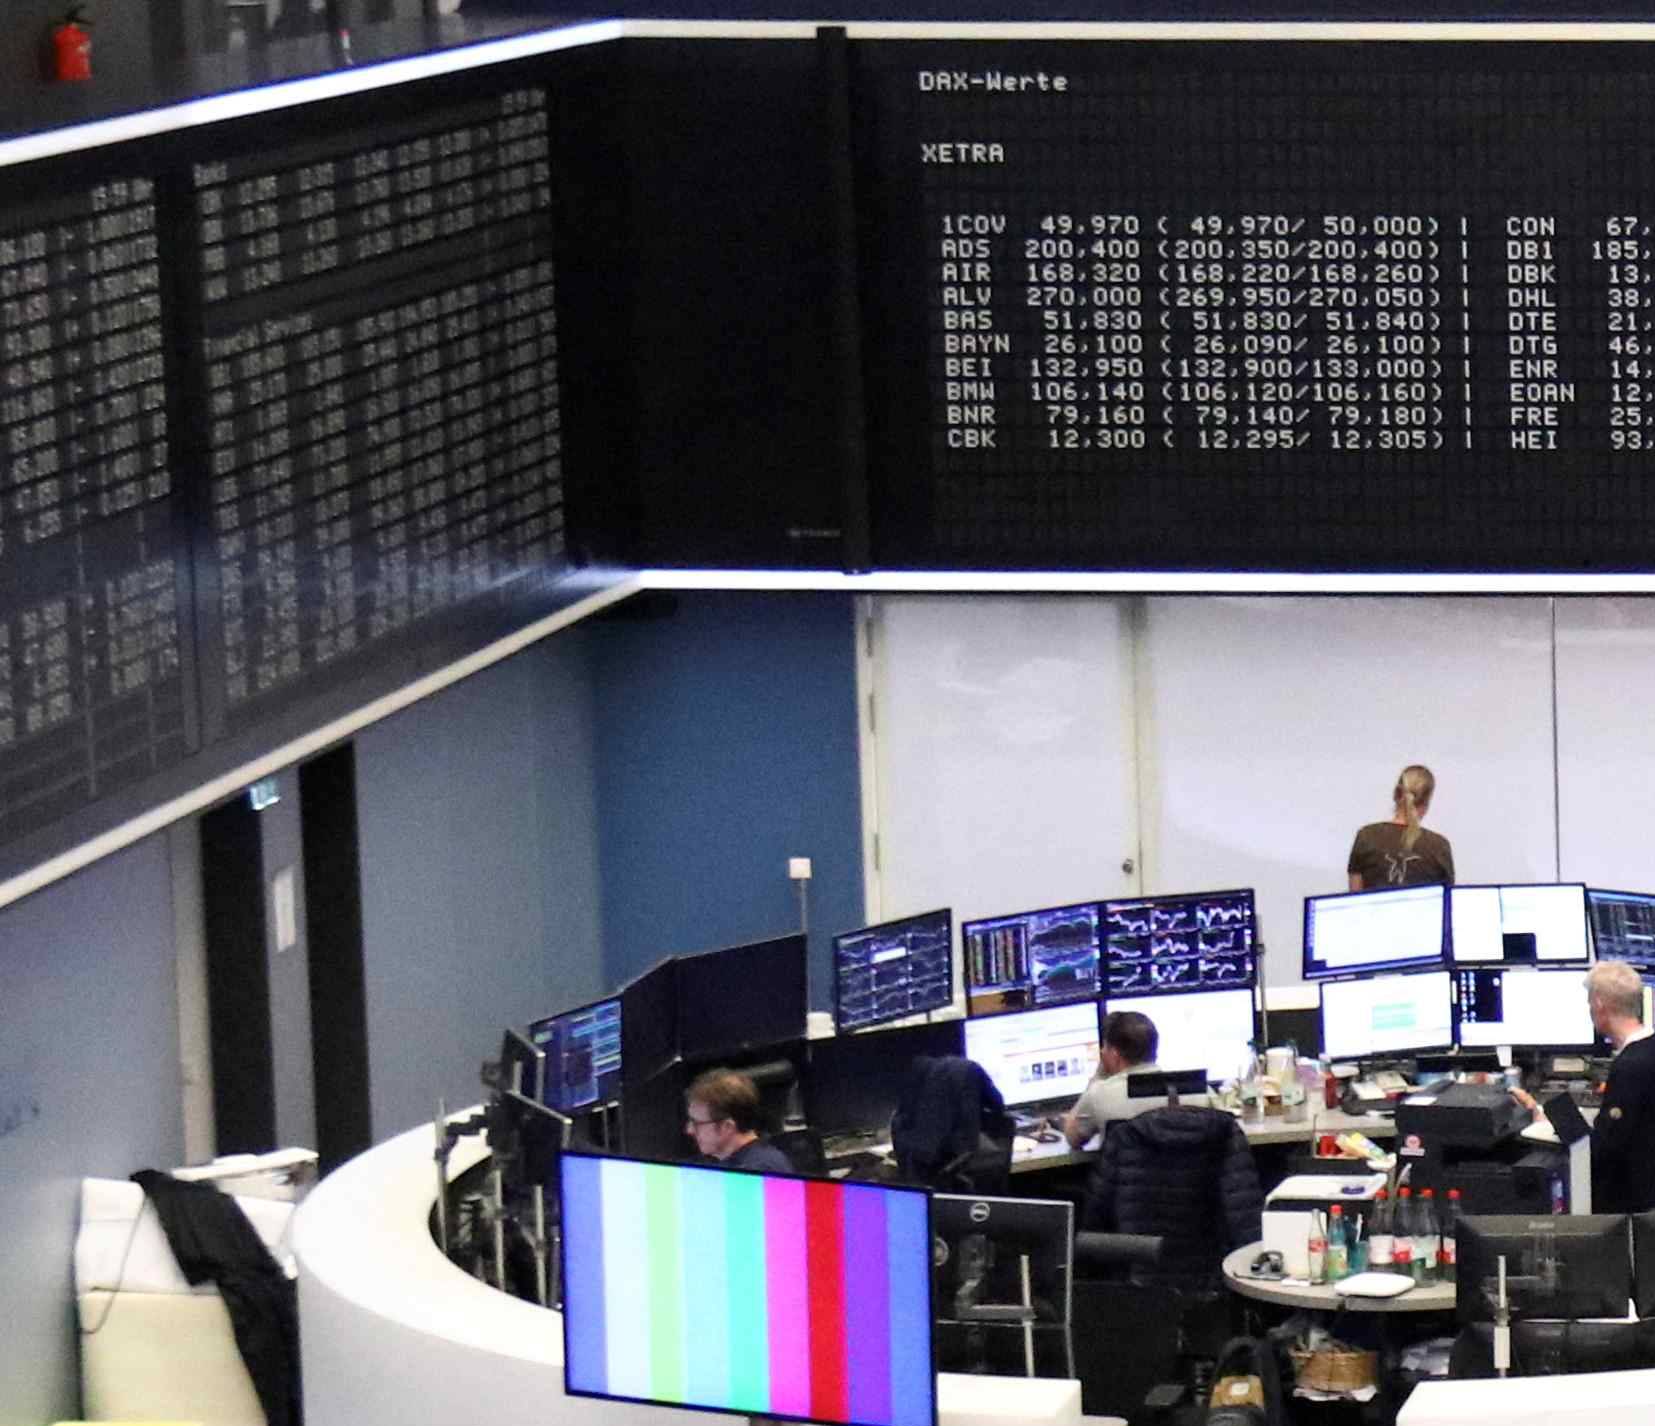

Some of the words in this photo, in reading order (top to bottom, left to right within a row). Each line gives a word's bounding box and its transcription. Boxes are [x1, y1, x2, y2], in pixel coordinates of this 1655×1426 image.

[918, 71, 1068, 91] DAX-Werte
[921, 142, 1004, 163] XETRA
[943, 214, 1006, 235] 1COV
[1041, 215, 1139, 235] 49,970
[1506, 216, 1555, 236] CON
[941, 238, 990, 259] ADS
[1025, 238, 1140, 259] 200,400
[1506, 240, 1553, 260] DB1
[942, 262, 991, 282] AIR
[1028, 262, 1141, 283] 168,320
[1507, 263, 1556, 284] DBK
[943, 286, 991, 306] ALV
[1026, 286, 1141, 306] 270,000
[1507, 287, 1556, 308] DHL
[943, 309, 992, 330] BAS
[1043, 310, 1142, 330] 51,830
[1508, 311, 1557, 332] DTE
[944, 333, 1010, 354] BAYN
[1045, 334, 1143, 354] 26,100
[1509, 335, 1558, 355] DTG
[945, 357, 991, 377] BEI
[1031, 357, 1143, 378] 132,950
[1509, 359, 1558, 379] ENR
[946, 381, 995, 401] BMW
[1031, 381, 1144, 401] 106,140
[1509, 382, 1575, 403] EOAN
[947, 405, 995, 424] BNR
[1047, 405, 1145, 425] 79,160
[1510, 406, 1559, 426] FRE
[947, 428, 995, 448] CBK
[1050, 428, 1145, 449] 12,300
[1511, 430, 1557, 450] HEI
